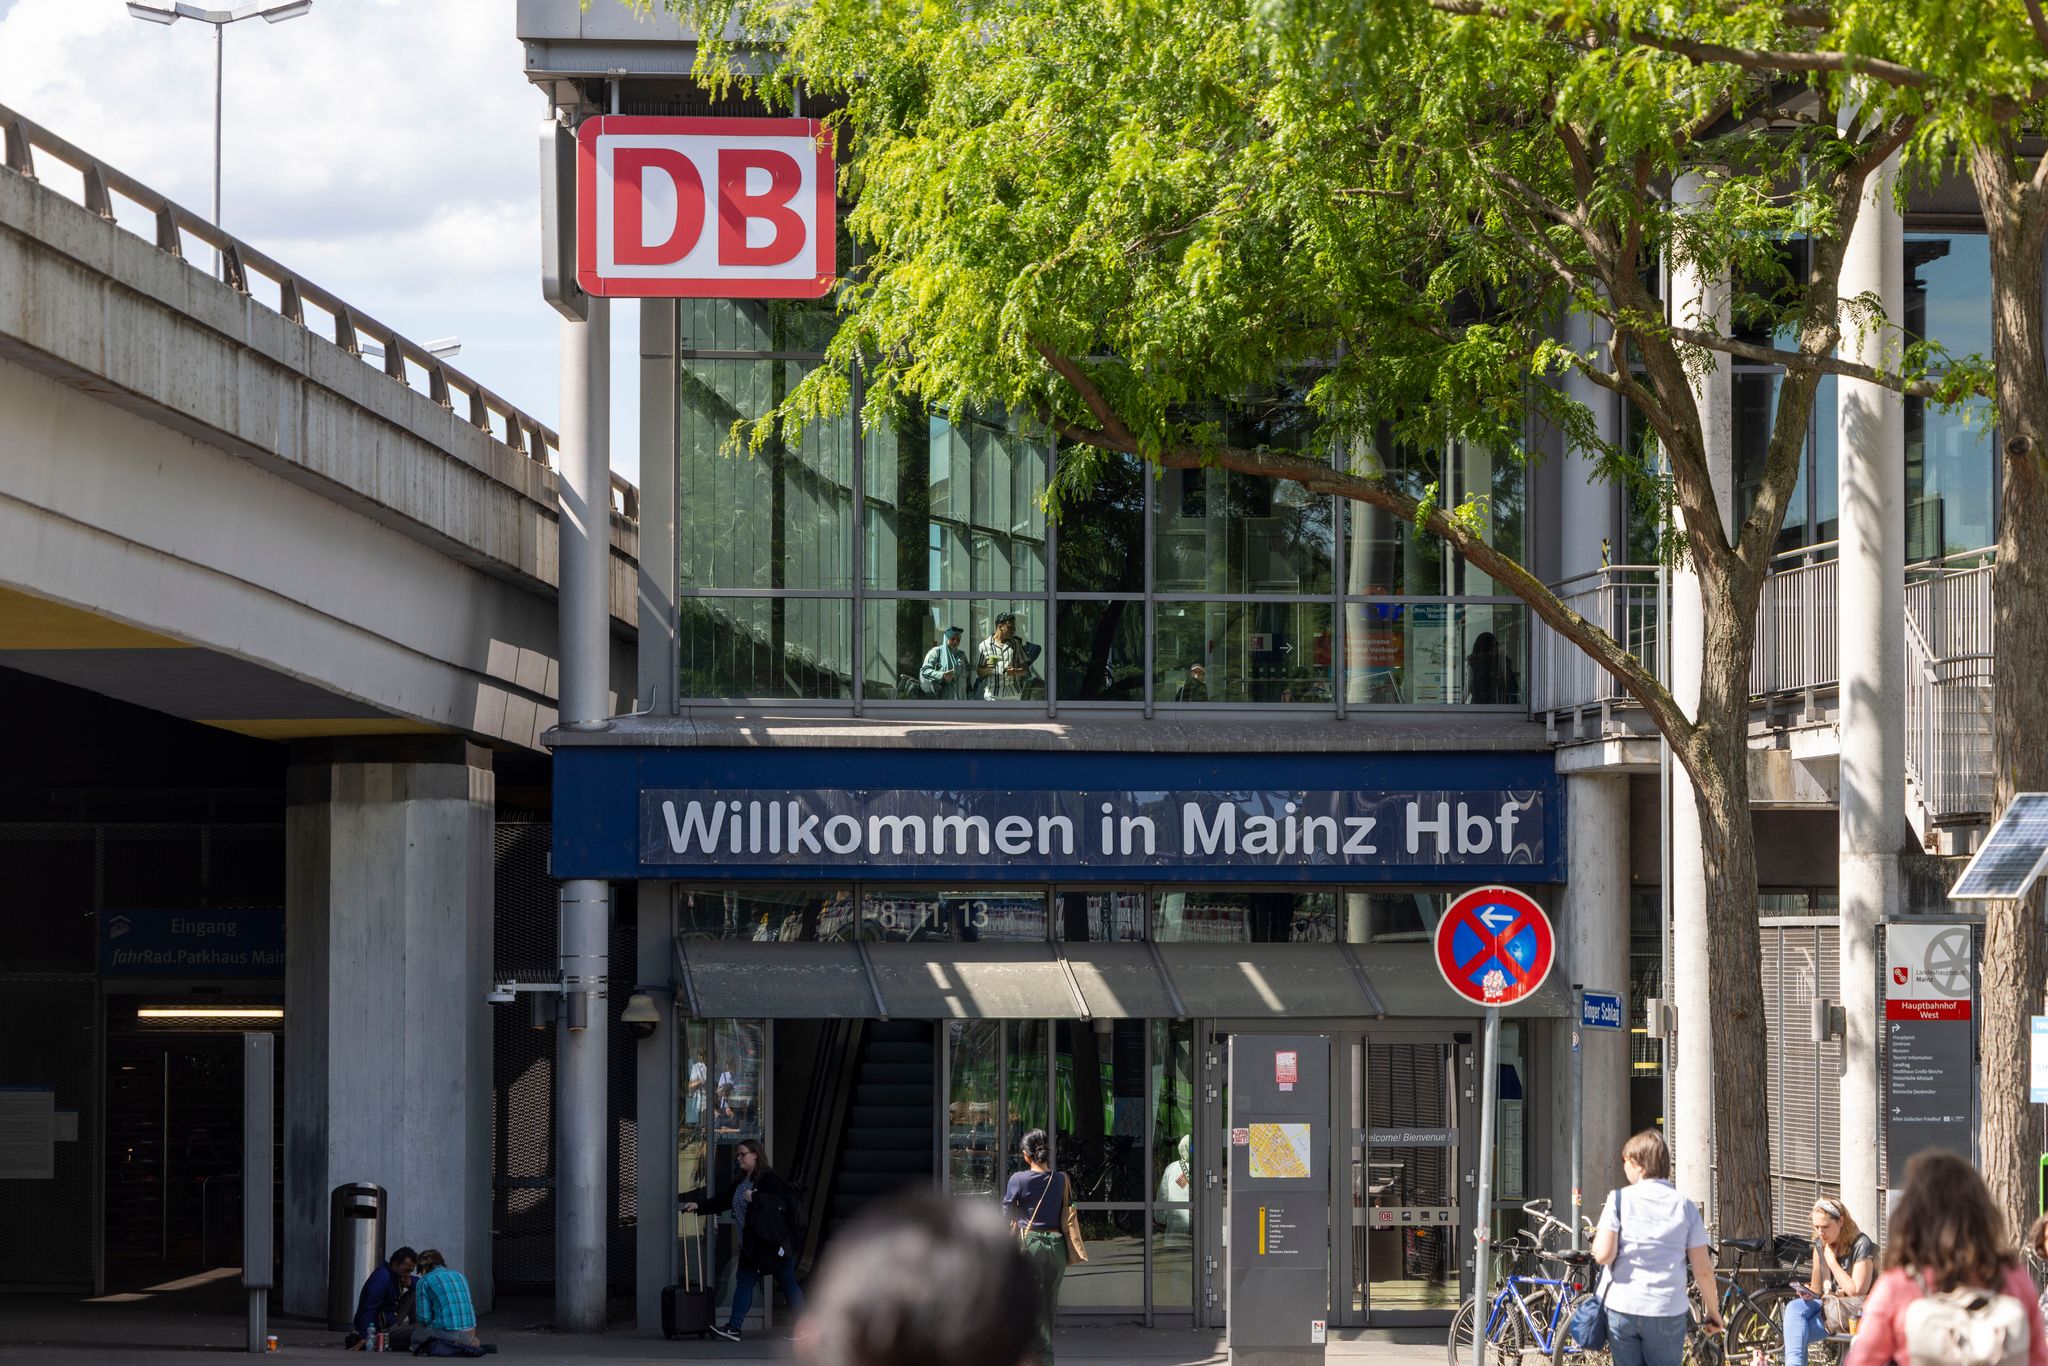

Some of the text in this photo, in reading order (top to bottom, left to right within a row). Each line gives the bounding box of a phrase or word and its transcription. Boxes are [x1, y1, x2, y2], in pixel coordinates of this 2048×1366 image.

[613, 147, 806, 266] DB
[661, 800, 1520, 856] Willkommen in Mainz Hbf
[880, 900, 989, 933] 8, 11, 13
[171, 918, 238, 937] Eingang
[112, 949, 248, 966] fahrRad.Parkhaus
[1584, 1000, 1601, 1024] Binger
[1601, 1002, 1620, 1027] Schlag
[1901, 1002, 1958, 1012] Hauptbahnhof
[1919, 1011, 1940, 1019] West
[1403, 1133, 1446, 1142] Bienvenue
[1380, 1212, 1392, 1220] DB
